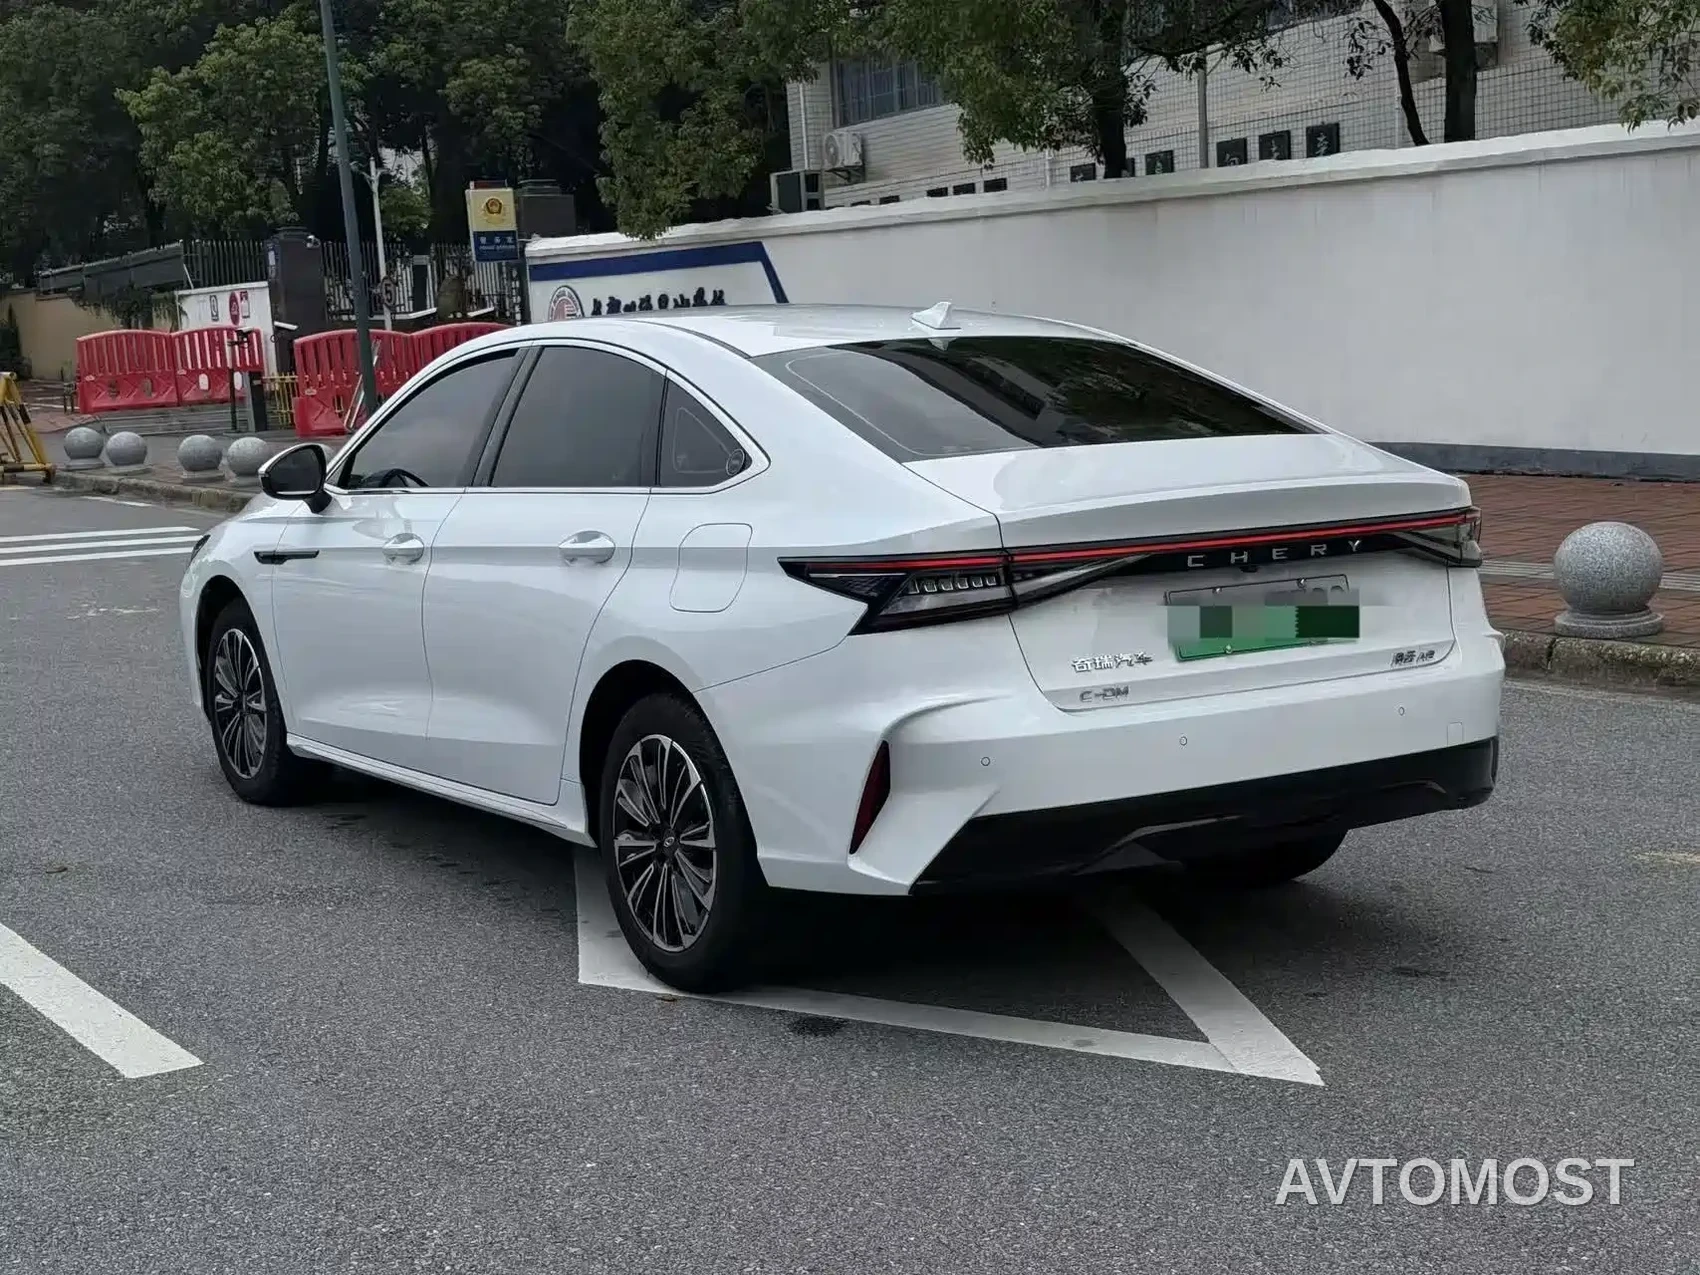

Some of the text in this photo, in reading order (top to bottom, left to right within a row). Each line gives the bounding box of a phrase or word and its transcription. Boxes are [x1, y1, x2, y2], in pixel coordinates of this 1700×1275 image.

[1187, 539, 1362, 568] CHERY
[1071, 651, 1153, 673] 奇瑞汽车
[1080, 685, 1129, 702] C-DM
